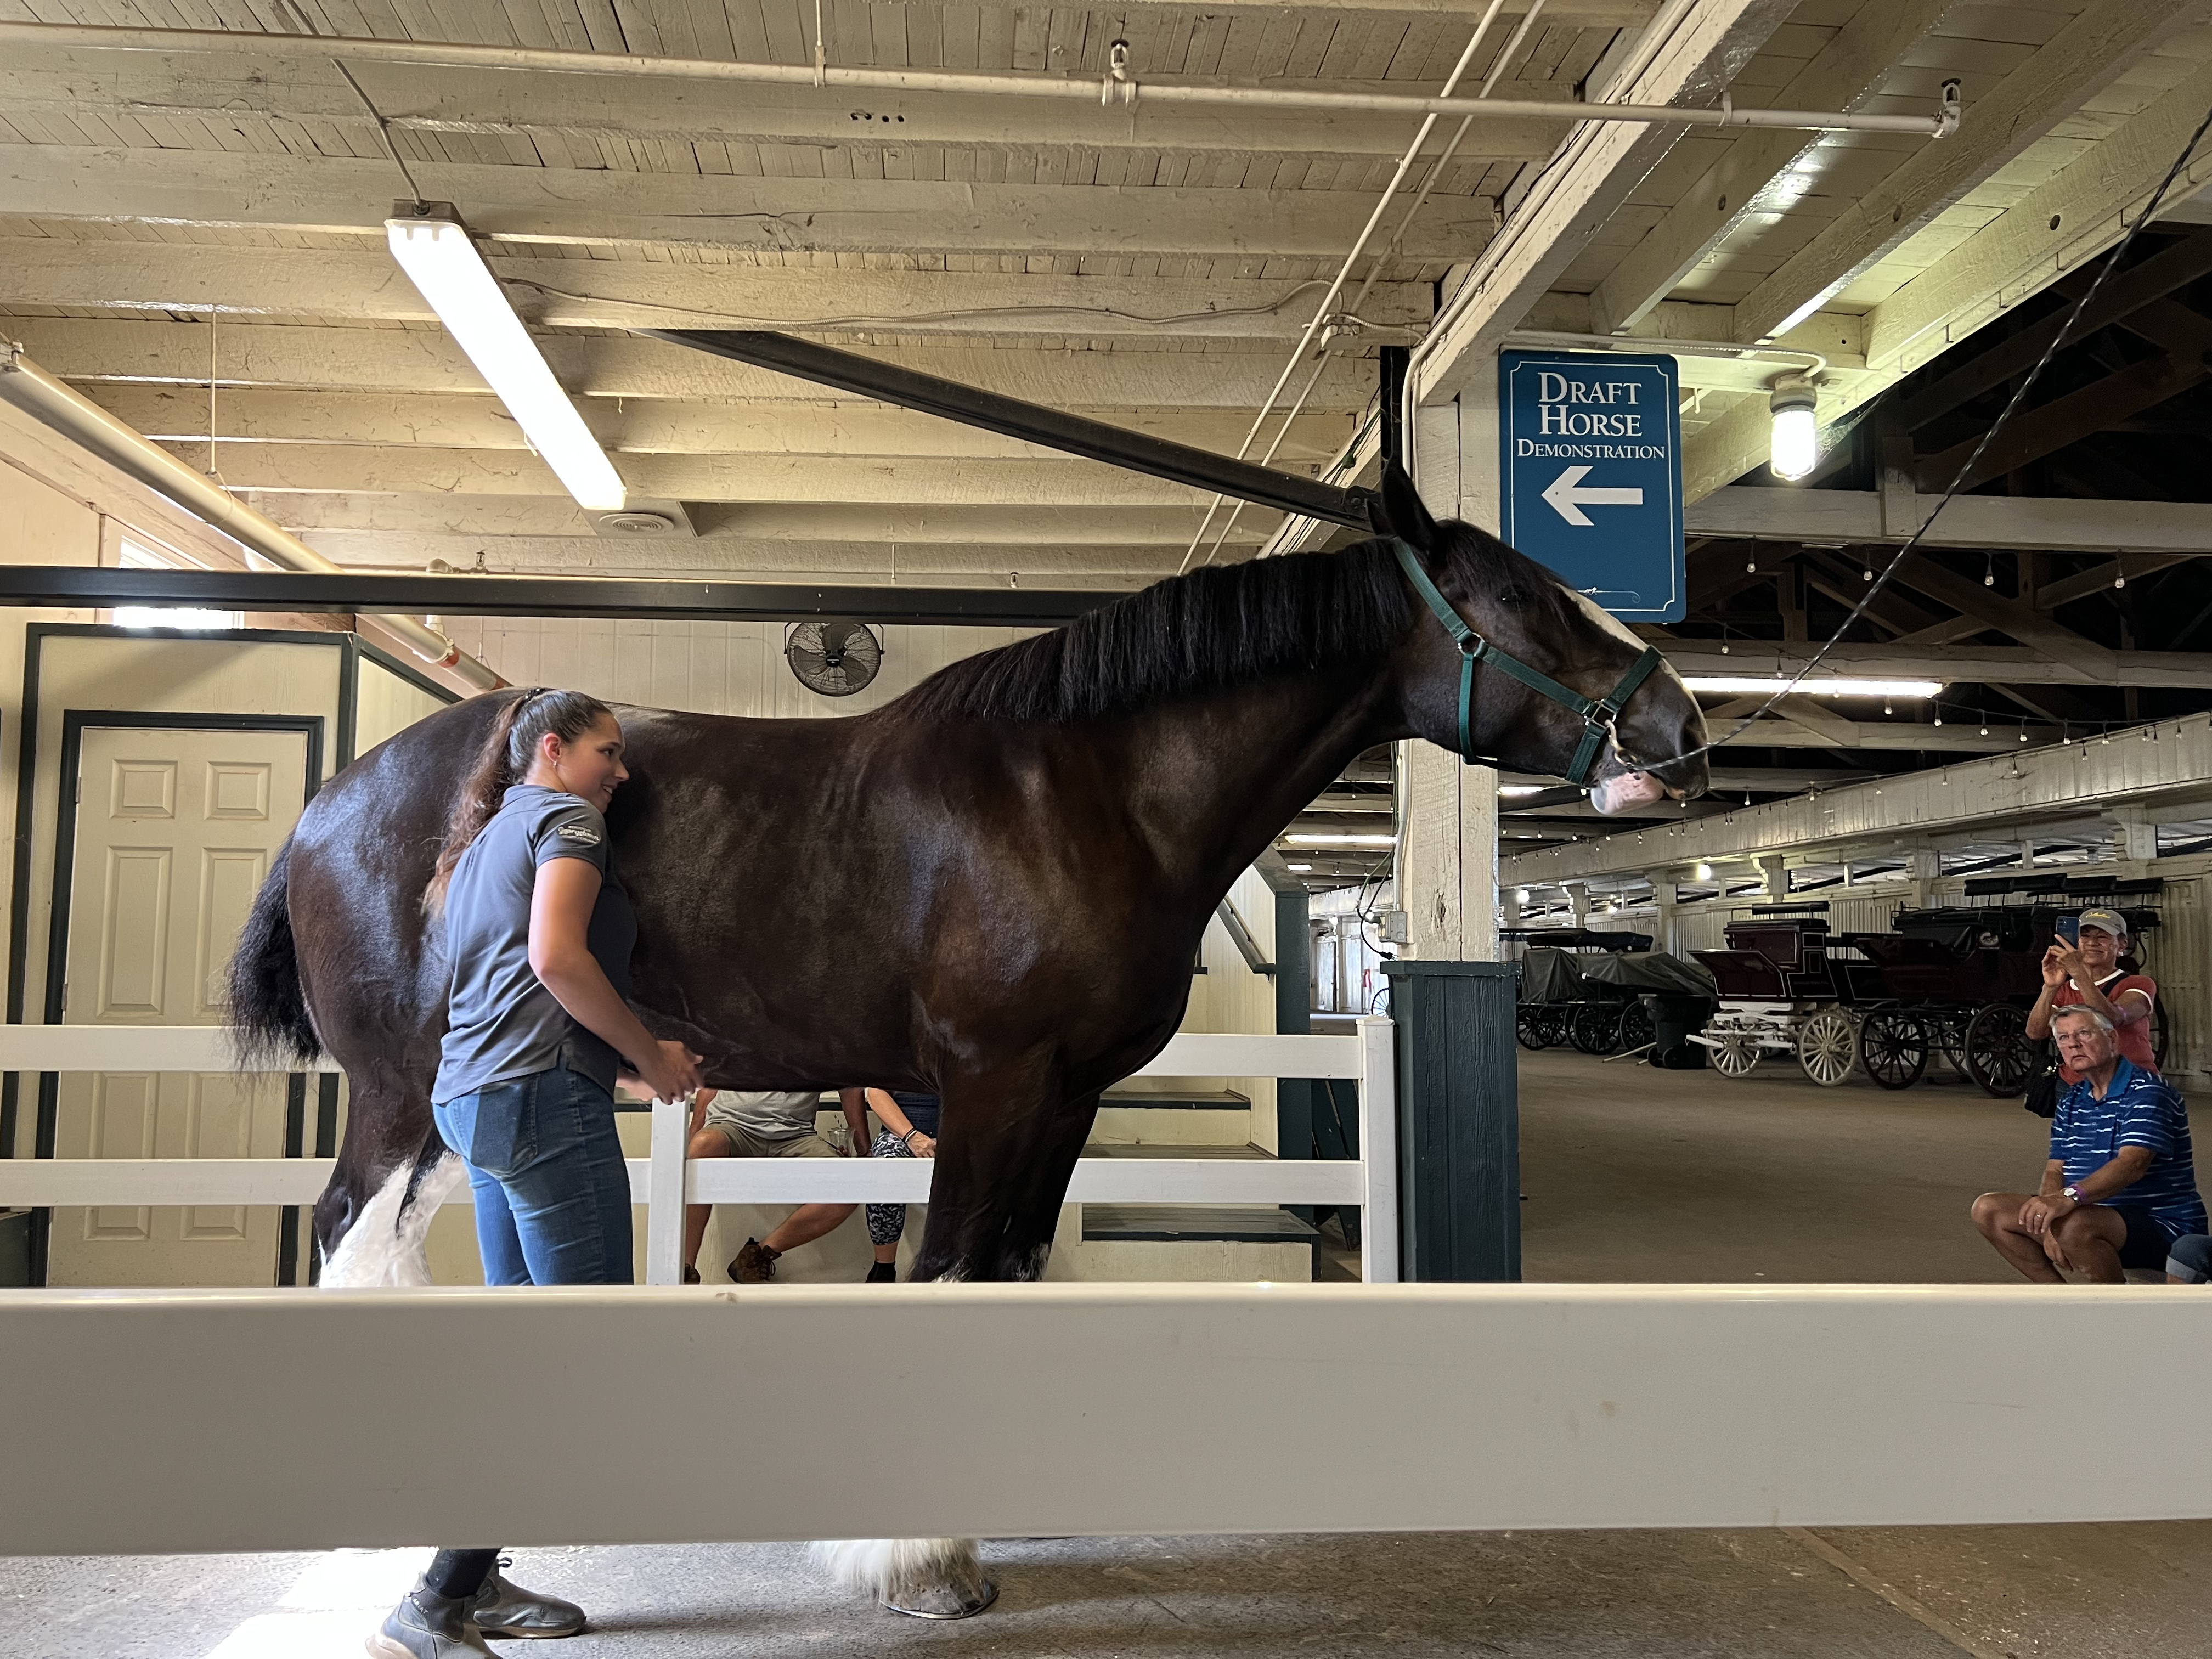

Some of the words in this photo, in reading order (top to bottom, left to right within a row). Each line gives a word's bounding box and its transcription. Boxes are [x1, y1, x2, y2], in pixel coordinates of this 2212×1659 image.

[1537, 371, 1642, 405] DRAFT
[1538, 404, 1643, 437] HORSE
[1516, 438, 1665, 459] DEMONSTRATION
